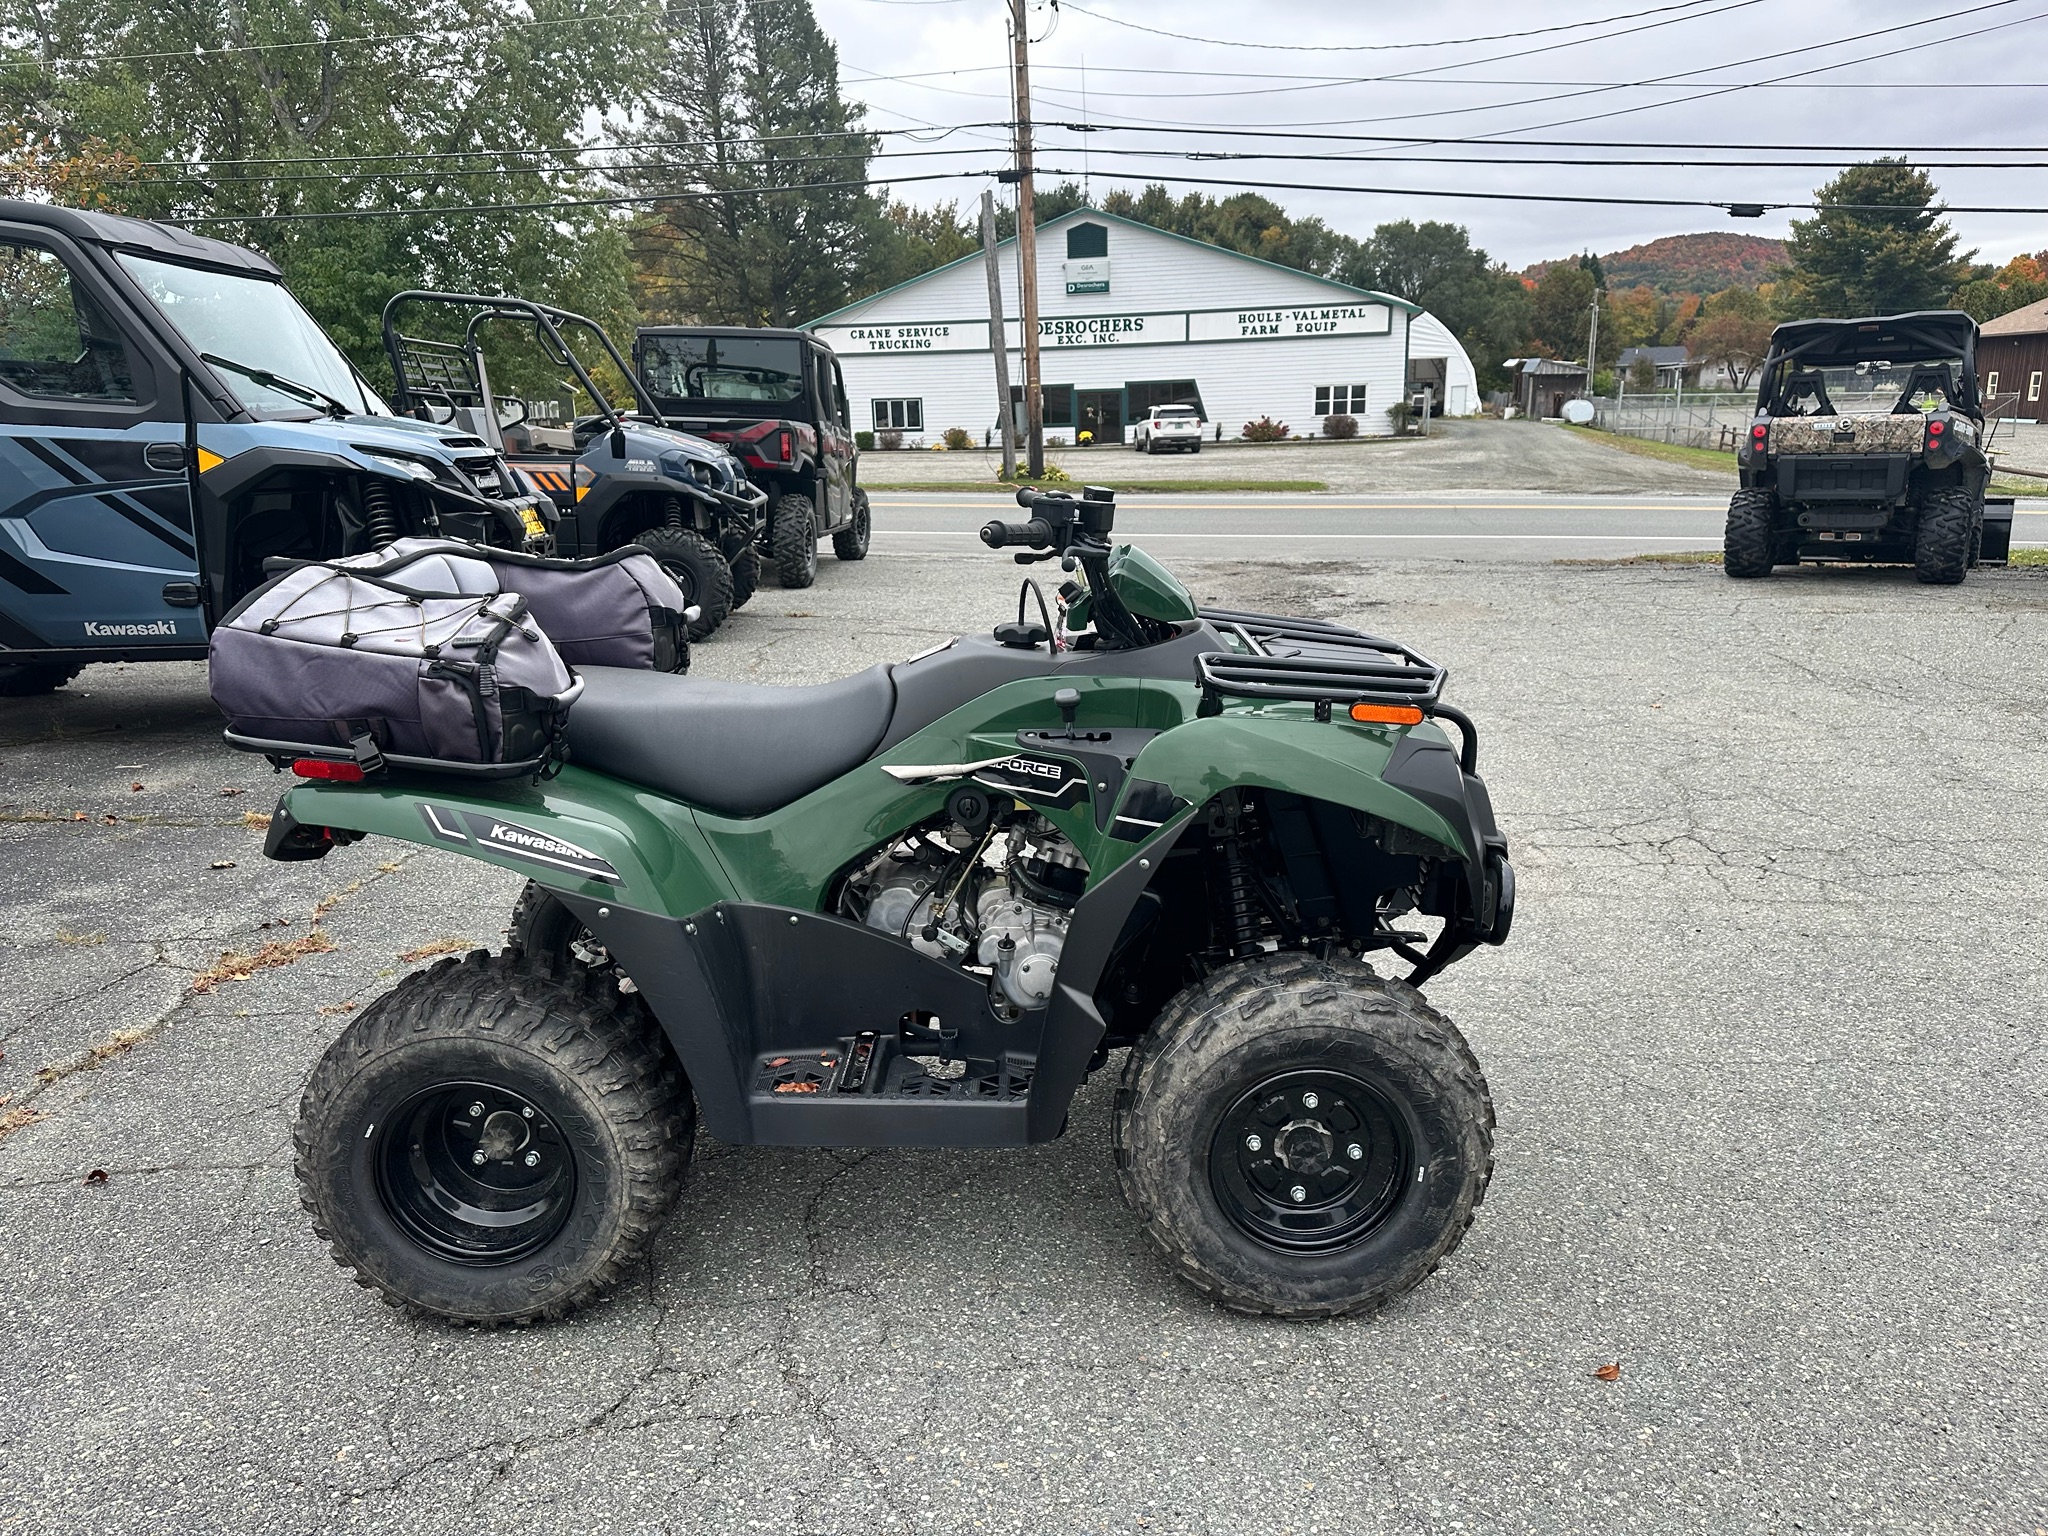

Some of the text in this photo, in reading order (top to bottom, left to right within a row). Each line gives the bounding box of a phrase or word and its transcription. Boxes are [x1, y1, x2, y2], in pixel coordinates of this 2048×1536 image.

[850, 327, 950, 339] CRANE SERVICE
[1241, 322, 1337, 335] FARM EQUIP
[869, 339, 932, 350] TRUCKING
[1057, 333, 1119, 344] EXC. INC.
[84, 620, 177, 636] Kawasaki
[490, 824, 583, 859] Kawasak
